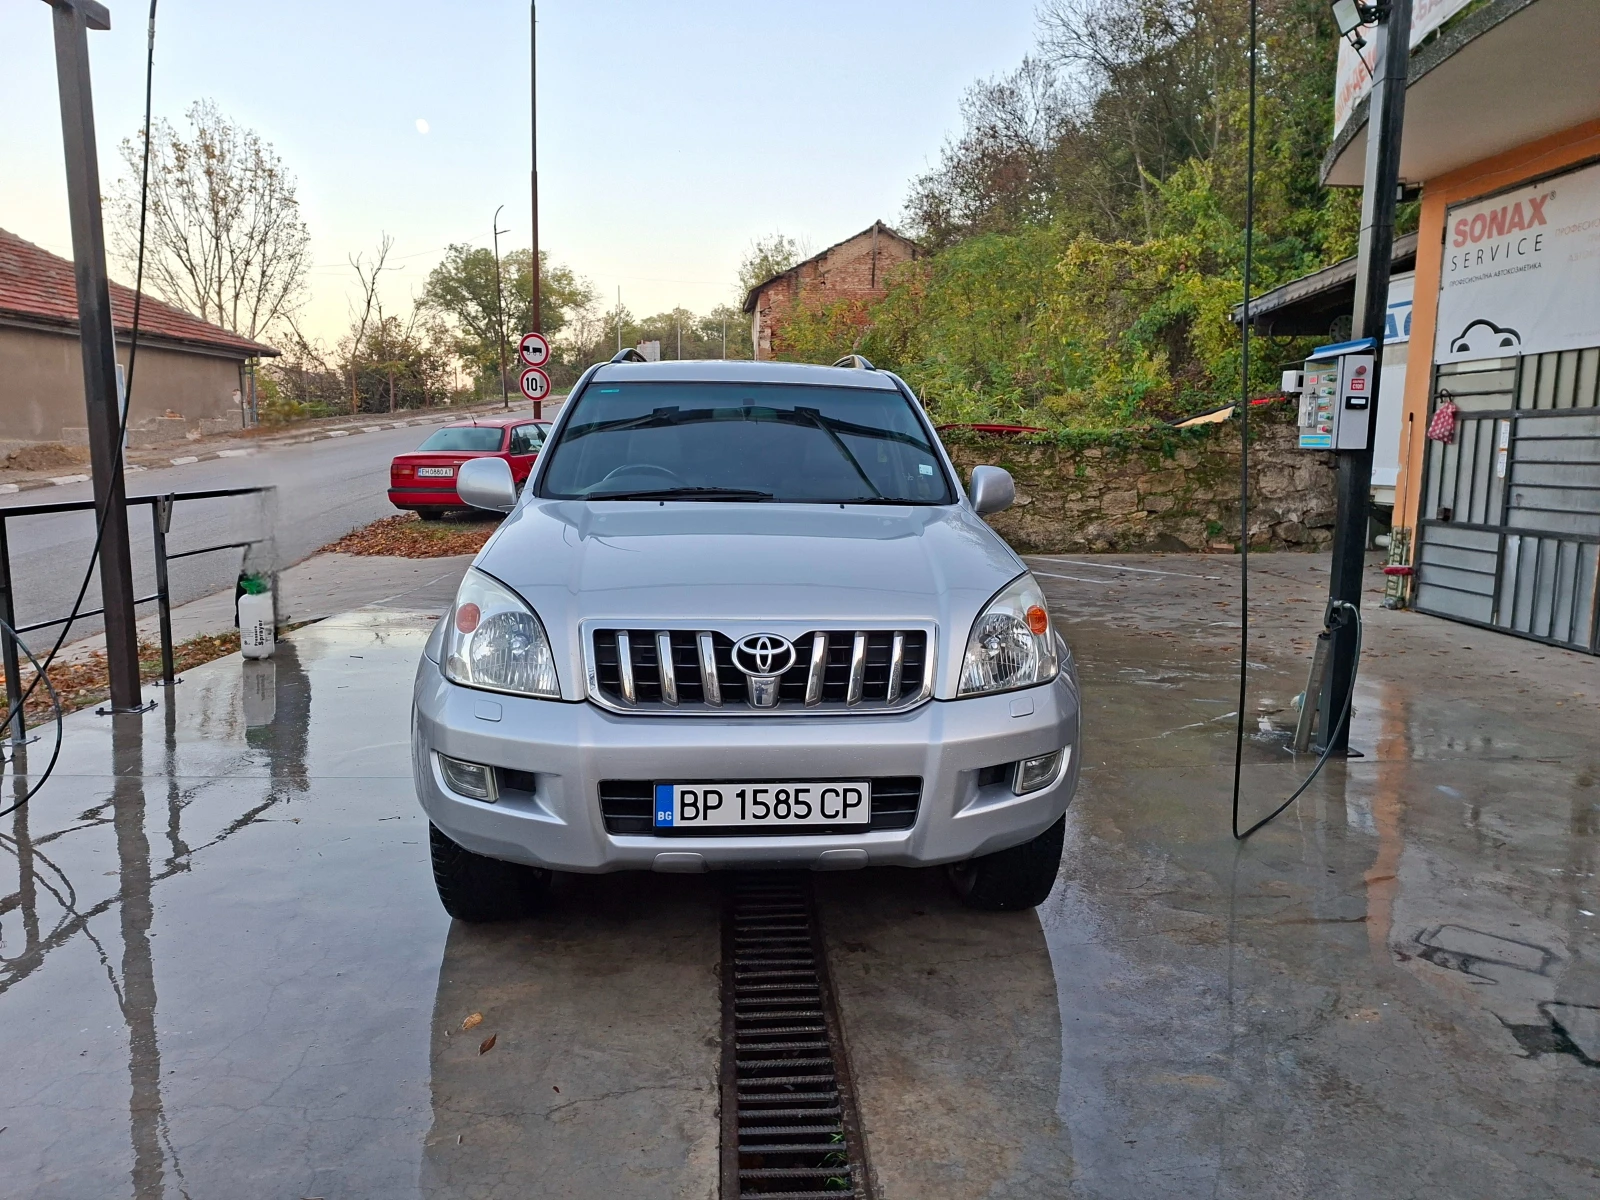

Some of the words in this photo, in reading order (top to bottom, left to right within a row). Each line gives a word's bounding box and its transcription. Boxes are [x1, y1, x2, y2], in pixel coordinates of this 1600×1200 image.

[1453, 194, 1549, 248] SONAX
[1451, 234, 1543, 271] SERVICE
[657, 811, 672, 821] BG
[679, 789, 724, 821] BP
[735, 788, 813, 820] 1585
[820, 787, 863, 819] CP
